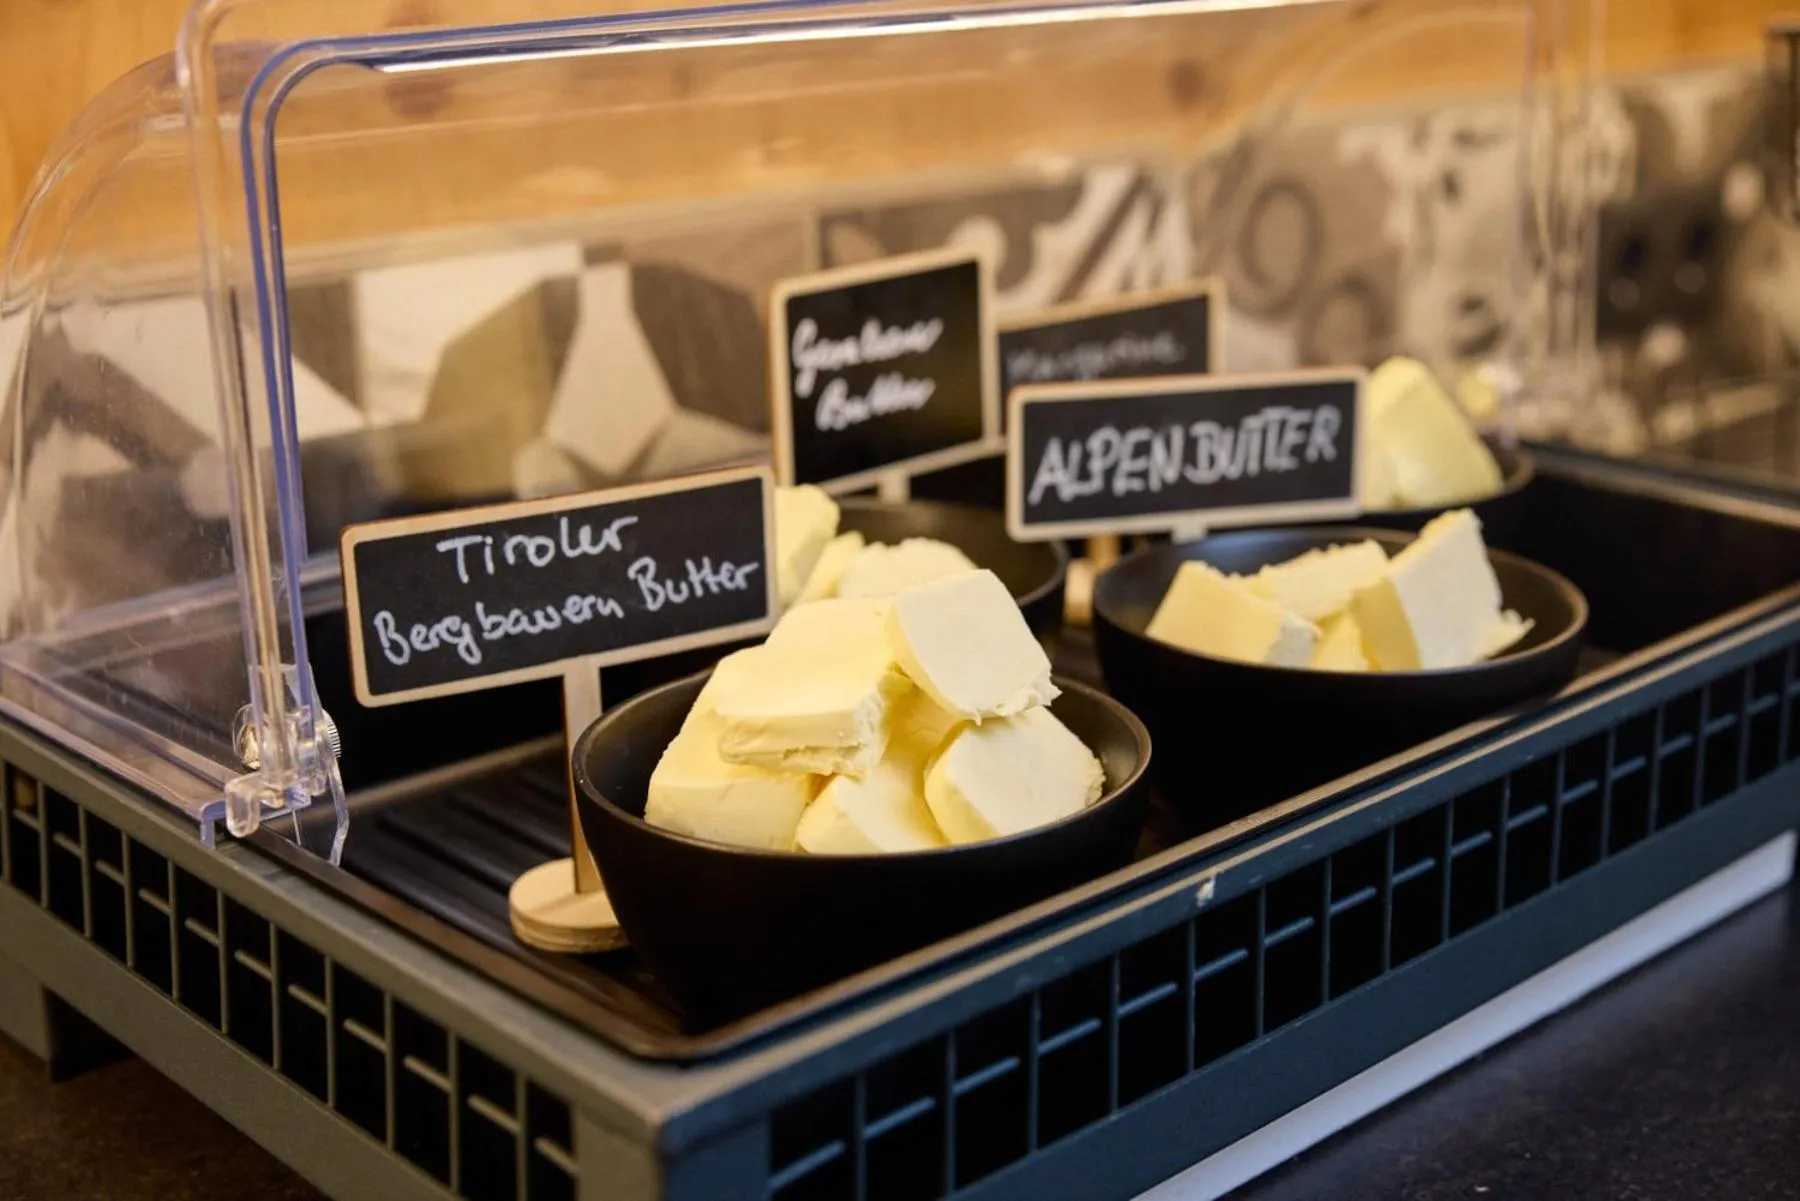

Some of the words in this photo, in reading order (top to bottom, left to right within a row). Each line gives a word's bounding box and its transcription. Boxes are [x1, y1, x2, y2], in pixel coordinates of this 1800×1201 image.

[815, 373, 936, 431] Butter
[436, 516, 639, 583] Tiroler
[373, 591, 625, 666] Bergbauern
[627, 556, 760, 611] Butter
